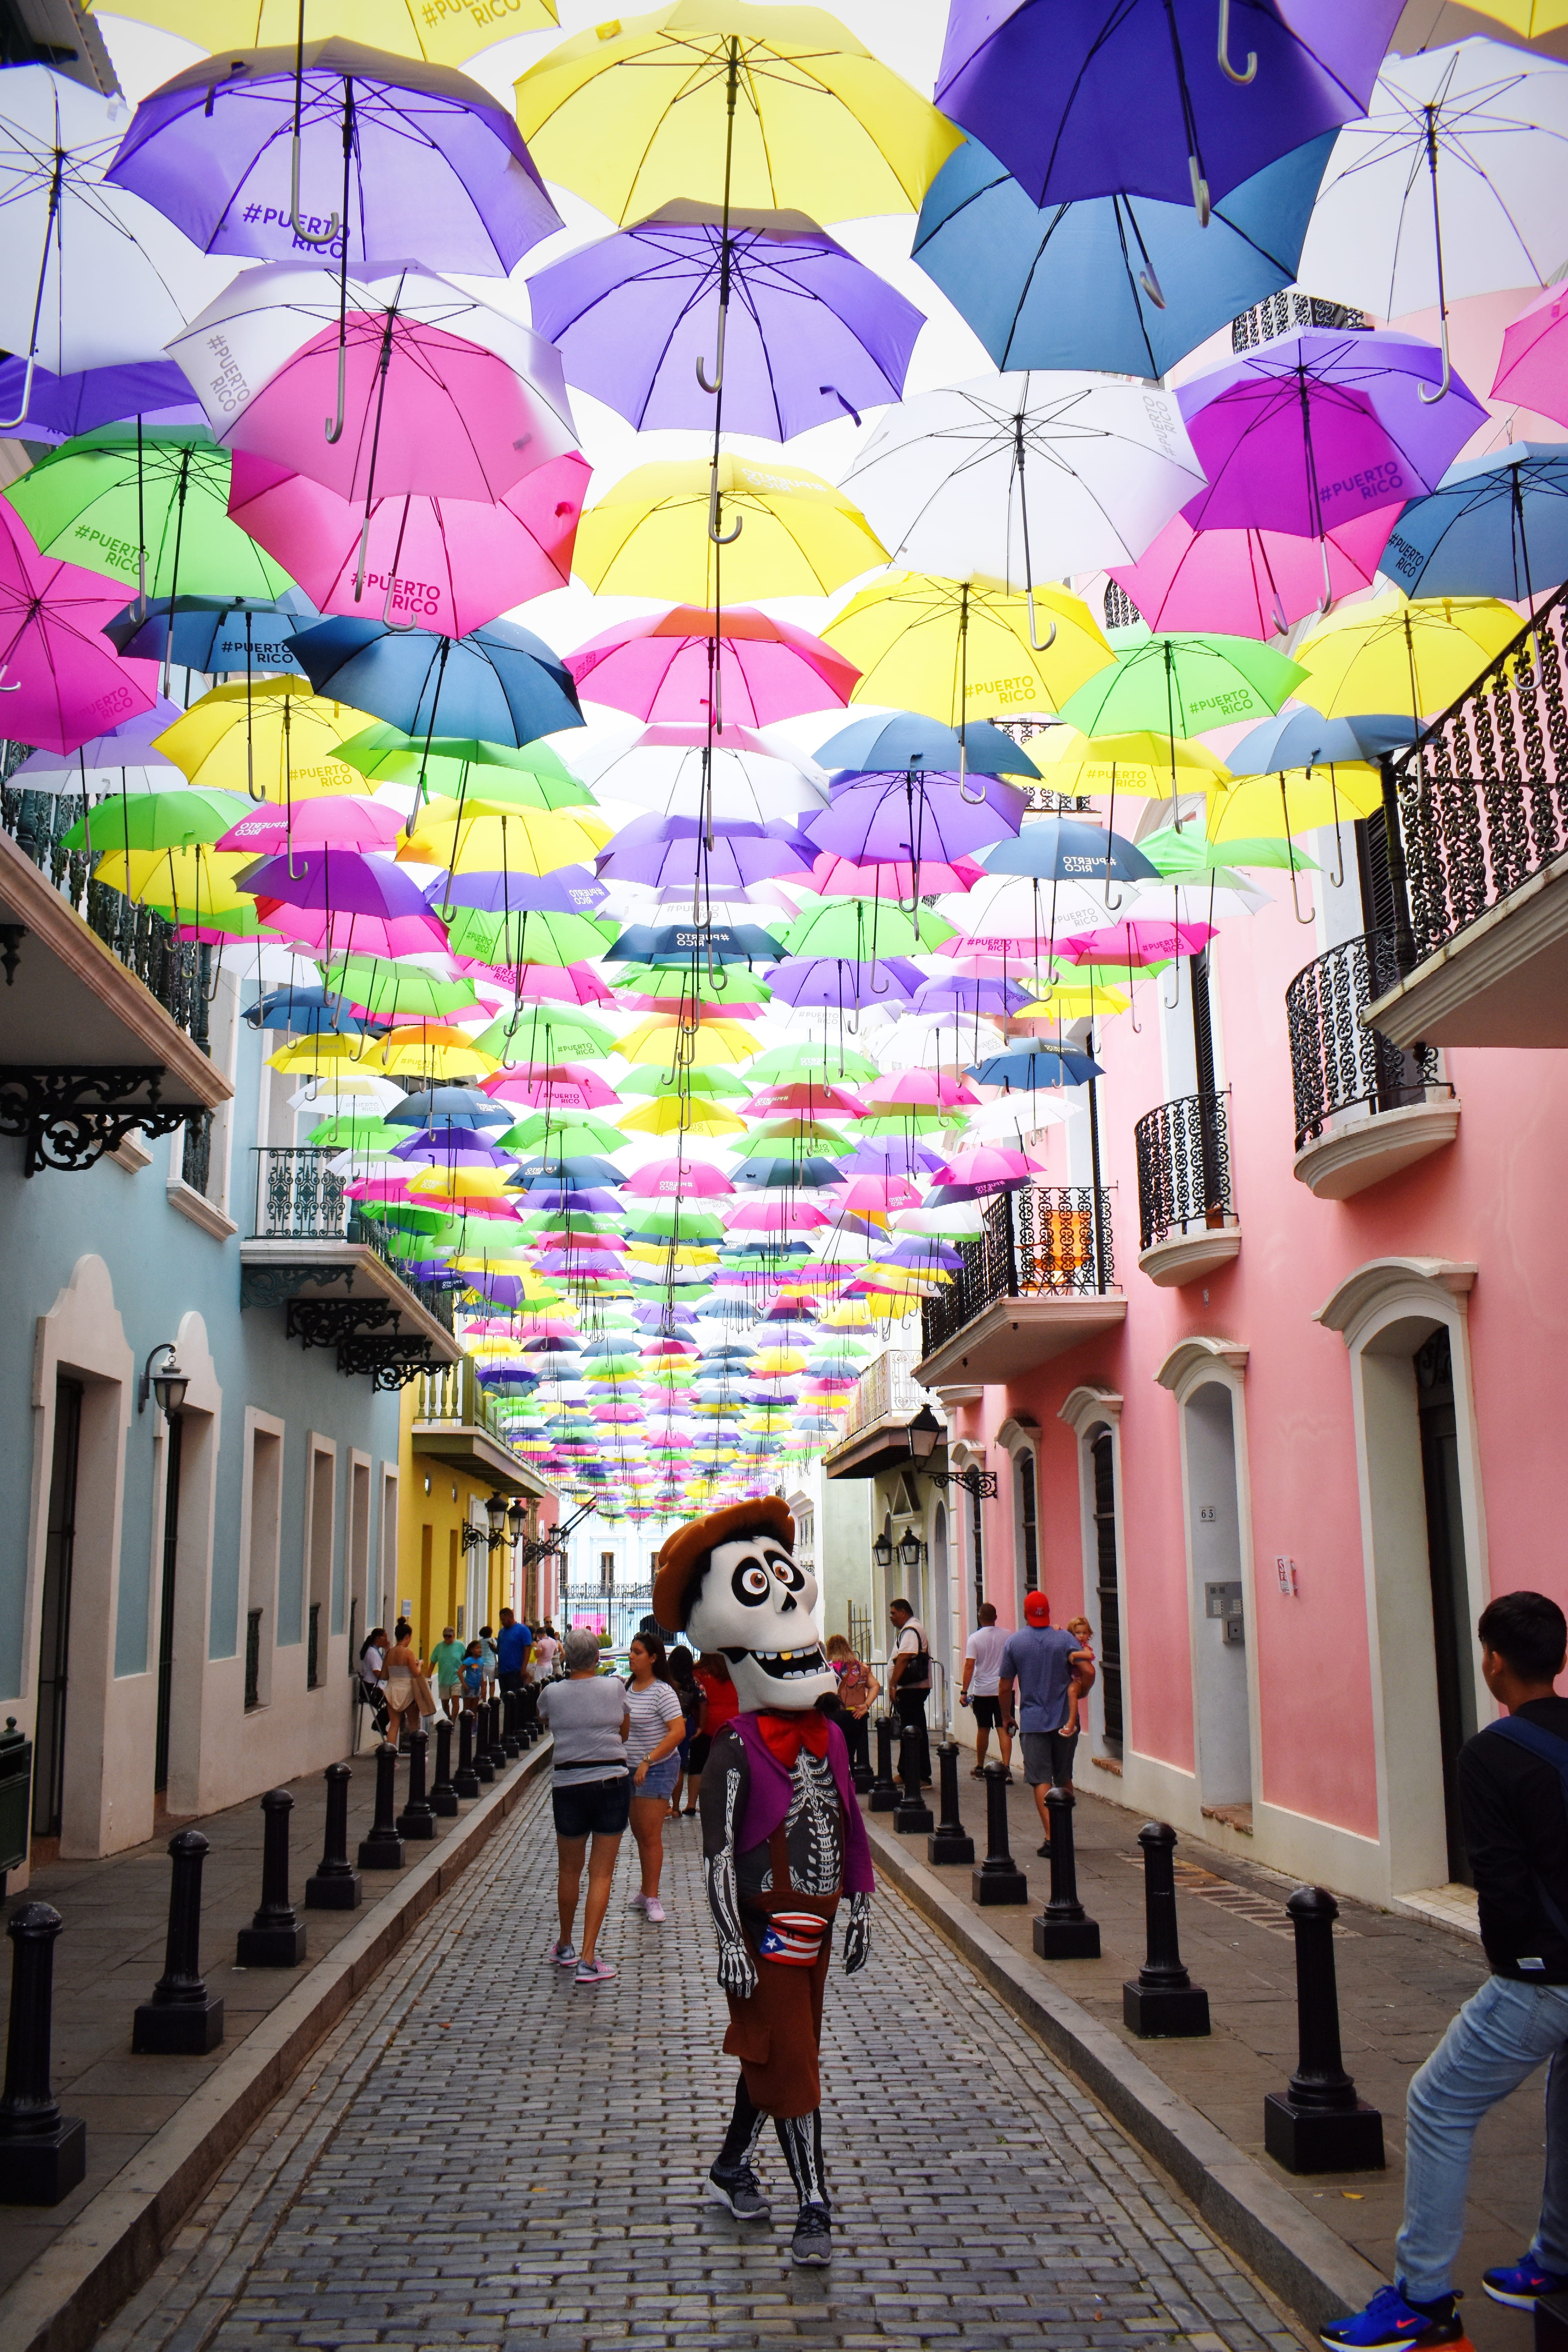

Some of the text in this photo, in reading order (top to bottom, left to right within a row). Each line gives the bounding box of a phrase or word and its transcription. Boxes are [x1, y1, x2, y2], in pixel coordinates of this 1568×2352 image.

[207, 334, 250, 402] #PUERTO
[210, 376, 237, 412] RICO
[1142, 395, 1176, 457] #PUERTO
[1156, 401, 1176, 435] RICO
[1319, 461, 1397, 503] #PUERTO
[1361, 475, 1403, 500] RICO
[74, 524, 150, 563] #PUERTO
[1388, 533, 1425, 566] #PUERTO
[1403, 557, 1423, 577] RICO
[351, 571, 440, 600] #PUERTO
[392, 594, 438, 615] RICO
[221, 641, 292, 653] #PUERTO
[257, 653, 293, 663] RICO
[965, 676, 1034, 699] #PUERTO
[999, 688, 1036, 704] RICO
[101, 697, 133, 720] RICO
[1189, 689, 1249, 714] #PUERTO
[1221, 699, 1253, 715] RICO
[289, 764, 350, 781] #PUERTO
[321, 774, 352, 787] RICO
[1087, 769, 1147, 779] #PUERTO
[1116, 779, 1147, 788] RICO
[1073, 915, 1099, 927] RICO
[466, 931, 493, 946] #PUERTO
[1142, 938, 1181, 952] #PUERTO
[475, 944, 490, 954] RICO
[1162, 943, 1184, 953] RICO
[477, 961, 517, 979] #UERTO
[494, 973, 515, 984] RICO
[557, 1043, 593, 1053] #PUERTO
[1201, 1509, 1213, 1518] 65
